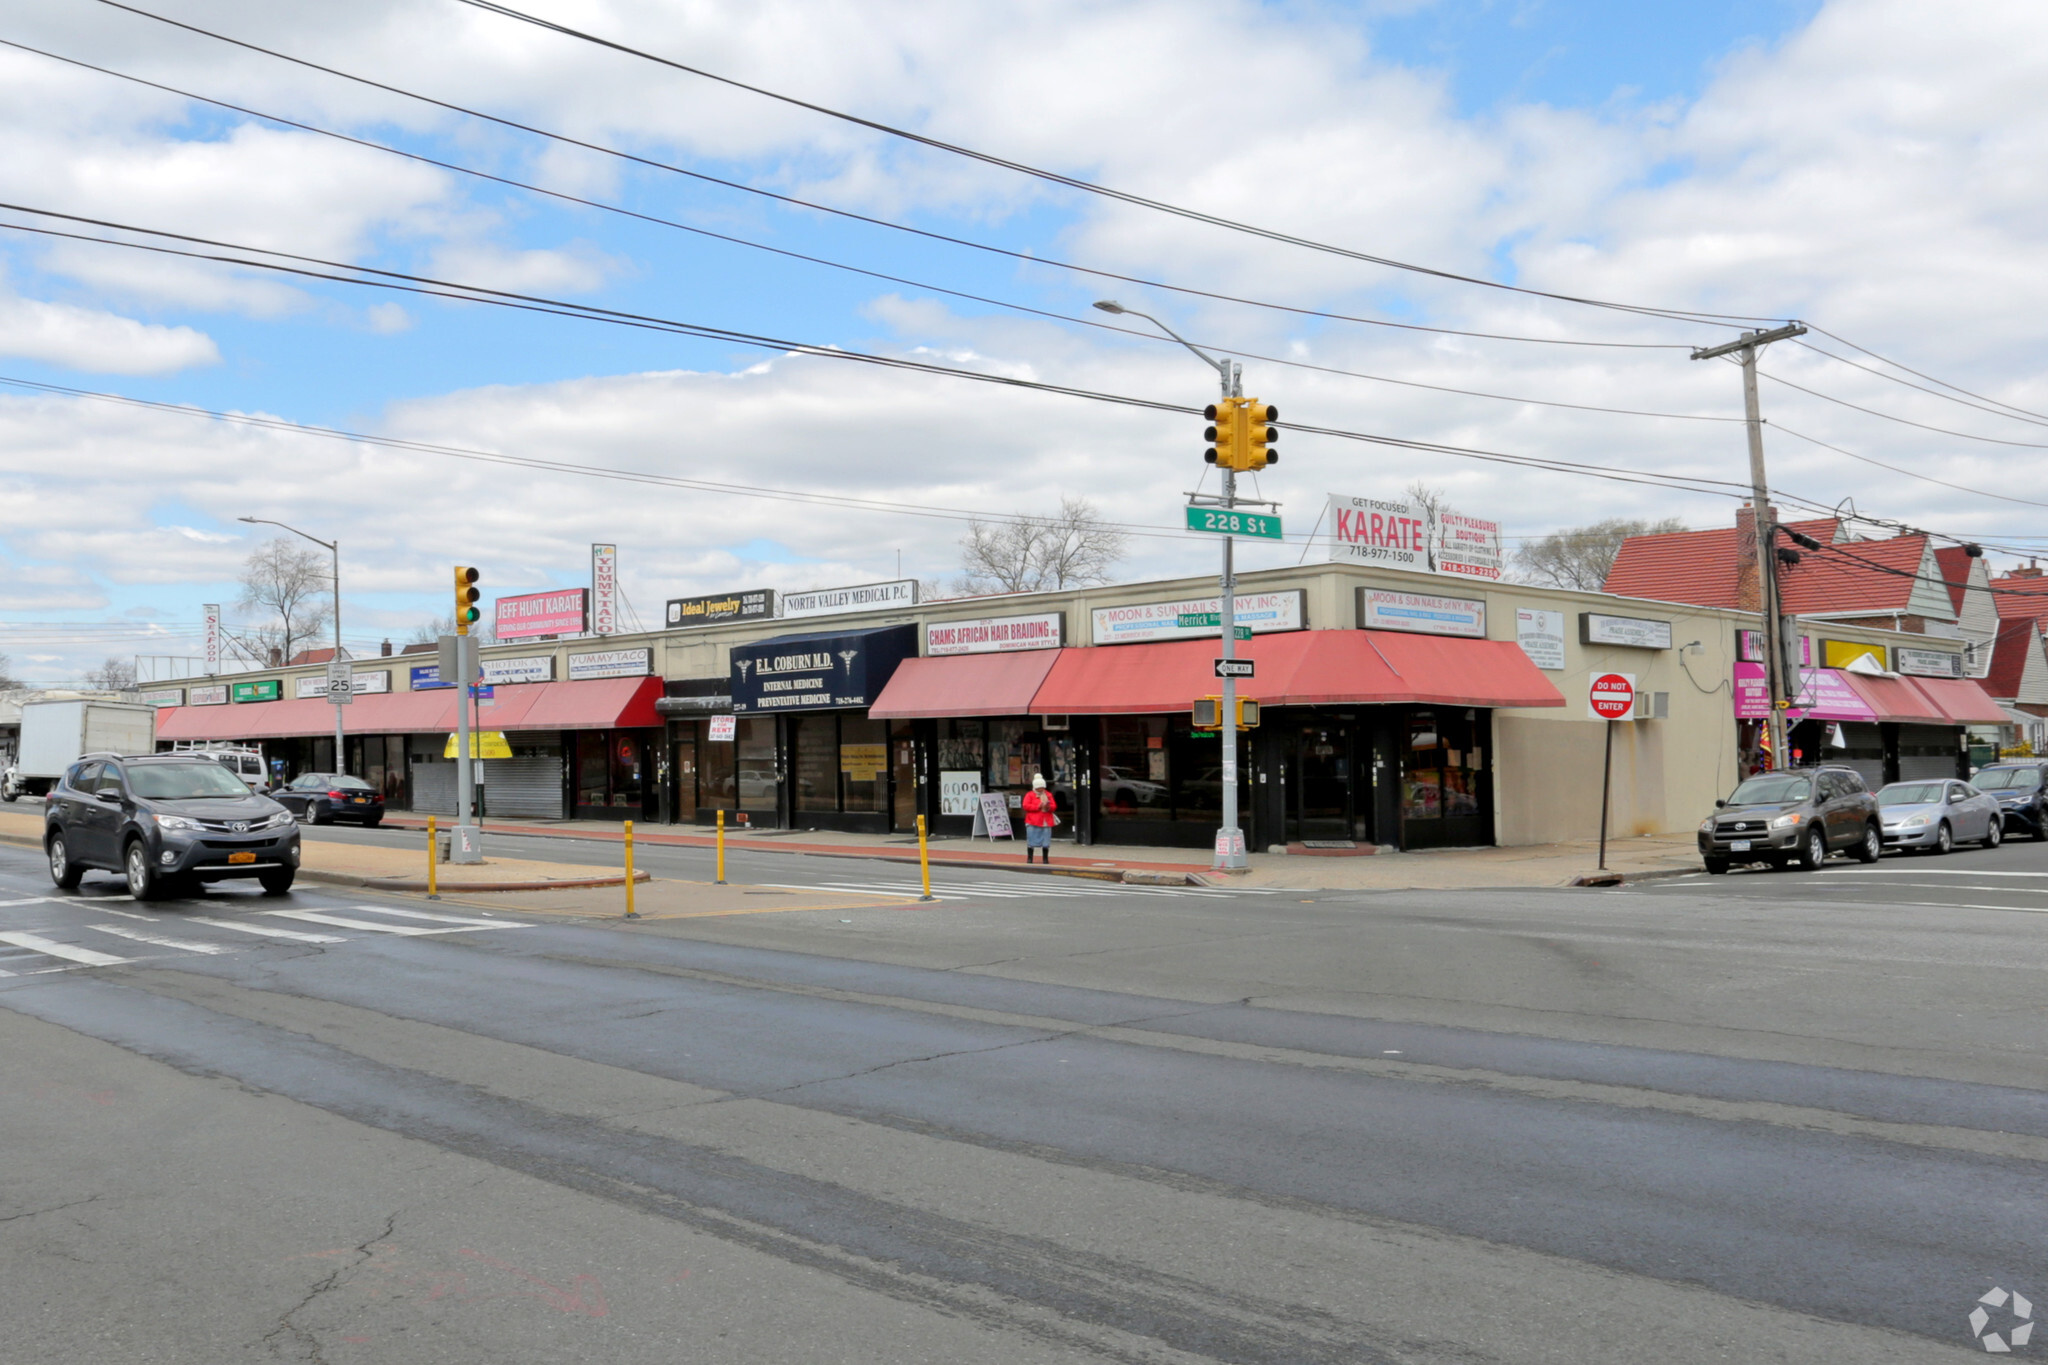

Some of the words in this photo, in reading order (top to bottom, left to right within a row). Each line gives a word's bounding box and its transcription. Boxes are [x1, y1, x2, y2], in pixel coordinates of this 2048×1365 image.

[1352, 497, 1368, 508] GET
[1370, 500, 1410, 514] FOCUSED!
[1205, 513, 1240, 530] 228
[1247, 517, 1267, 534] St
[1337, 508, 1424, 552] KARATE
[1441, 512, 1462, 526] GUILTY
[1464, 516, 1496, 532] PLEASURES
[1456, 529, 1486, 544] BOUTIQUE
[1350, 545, 1414, 563] 718-977-1500
[597, 558, 613, 598] YUMMY
[498, 602, 518, 619] JEFF
[519, 598, 544, 616] HUNT
[546, 594, 582, 614] KARATE
[788, 596, 816, 611] NORTH
[818, 592, 851, 608] VALLEY
[852, 586, 890, 604] MEDICAL
[894, 585, 908, 600] P.C.
[1373, 592, 1396, 604] MOON
[1406, 596, 1420, 606] SUN
[1422, 597, 1442, 608] NAILS
[682, 600, 704, 616] Ideal
[706, 597, 740, 617] Jewelry
[1108, 609, 1142, 622] MOON
[1146, 608, 1152, 618] &
[1157, 604, 1180, 617] SUN
[1182, 600, 1218, 614] NAILS
[1236, 598, 1254, 610] NY,
[1258, 596, 1280, 608] INC.
[597, 600, 613, 632] TACO
[1178, 614, 1208, 626] Merrick
[498, 623, 516, 632] SERVING
[517, 622, 527, 632] OUR
[528, 620, 554, 630] COMMUNITY
[556, 618, 568, 627] SINCE
[930, 628, 956, 646] CHAMS
[958, 626, 989, 644] AFRICAN
[990, 624, 1009, 642] HAIR
[1010, 620, 1049, 640] BRAIDING
[1234, 628, 1244, 638] 228
[206, 615, 216, 662] SEAFOOD
[484, 658, 549, 670] SHOTOKAN
[570, 652, 613, 665] YUMMY
[614, 650, 646, 662] TACO
[756, 658, 772, 672] E.L.
[774, 654, 811, 671] COBURN
[812, 652, 834, 668] M.D.
[1222, 664, 1235, 672] ONE
[1237, 664, 1250, 674] WAY
[331, 680, 350, 692] 25
[764, 680, 792, 692] INTERNAL
[793, 678, 823, 689] MEDICINE
[758, 695, 800, 708] PREVENTATIVE
[800, 694, 830, 704] MEDICINE
[1598, 702, 1624, 710] ENTER
